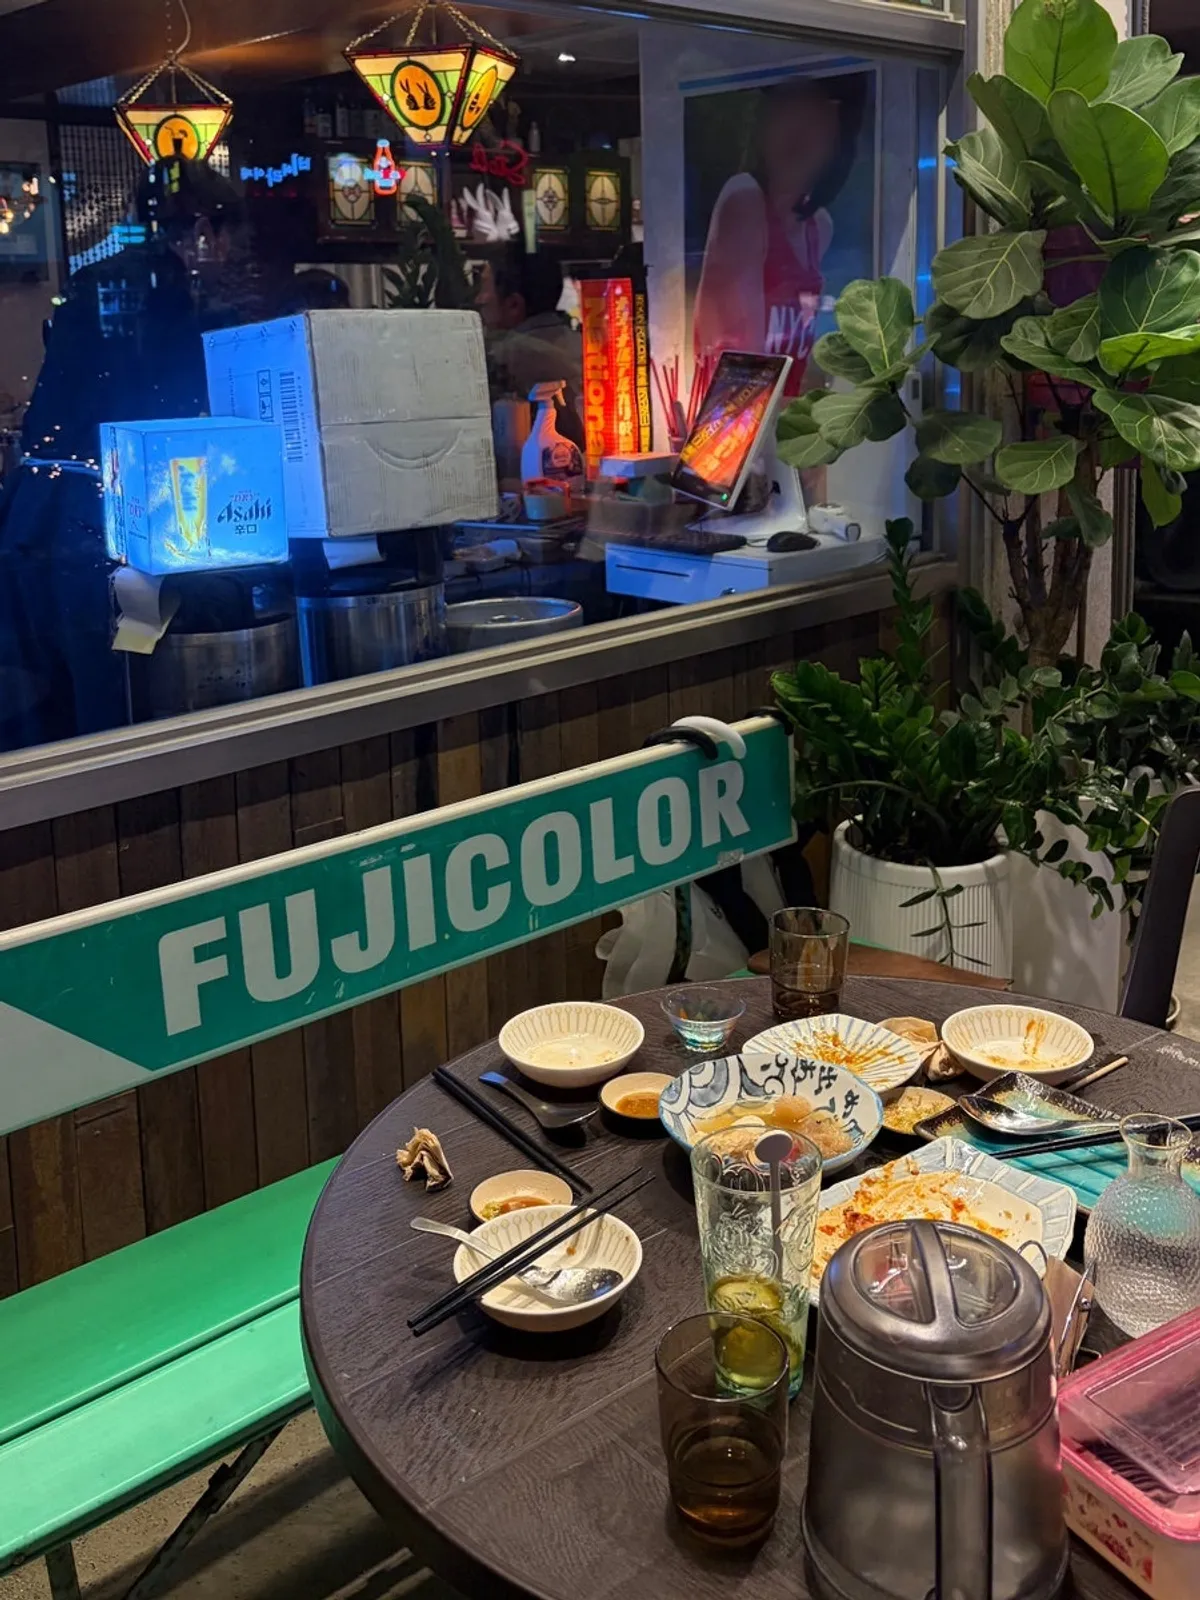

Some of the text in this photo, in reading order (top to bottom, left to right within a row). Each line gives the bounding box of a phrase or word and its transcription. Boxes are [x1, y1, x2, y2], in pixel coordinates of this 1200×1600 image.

[765, 305, 817, 359] NYC
[216, 497, 272, 523] Asahi
[234, 524, 257, 535] 辛口
[157, 760, 751, 1037] FUJICOLOR
